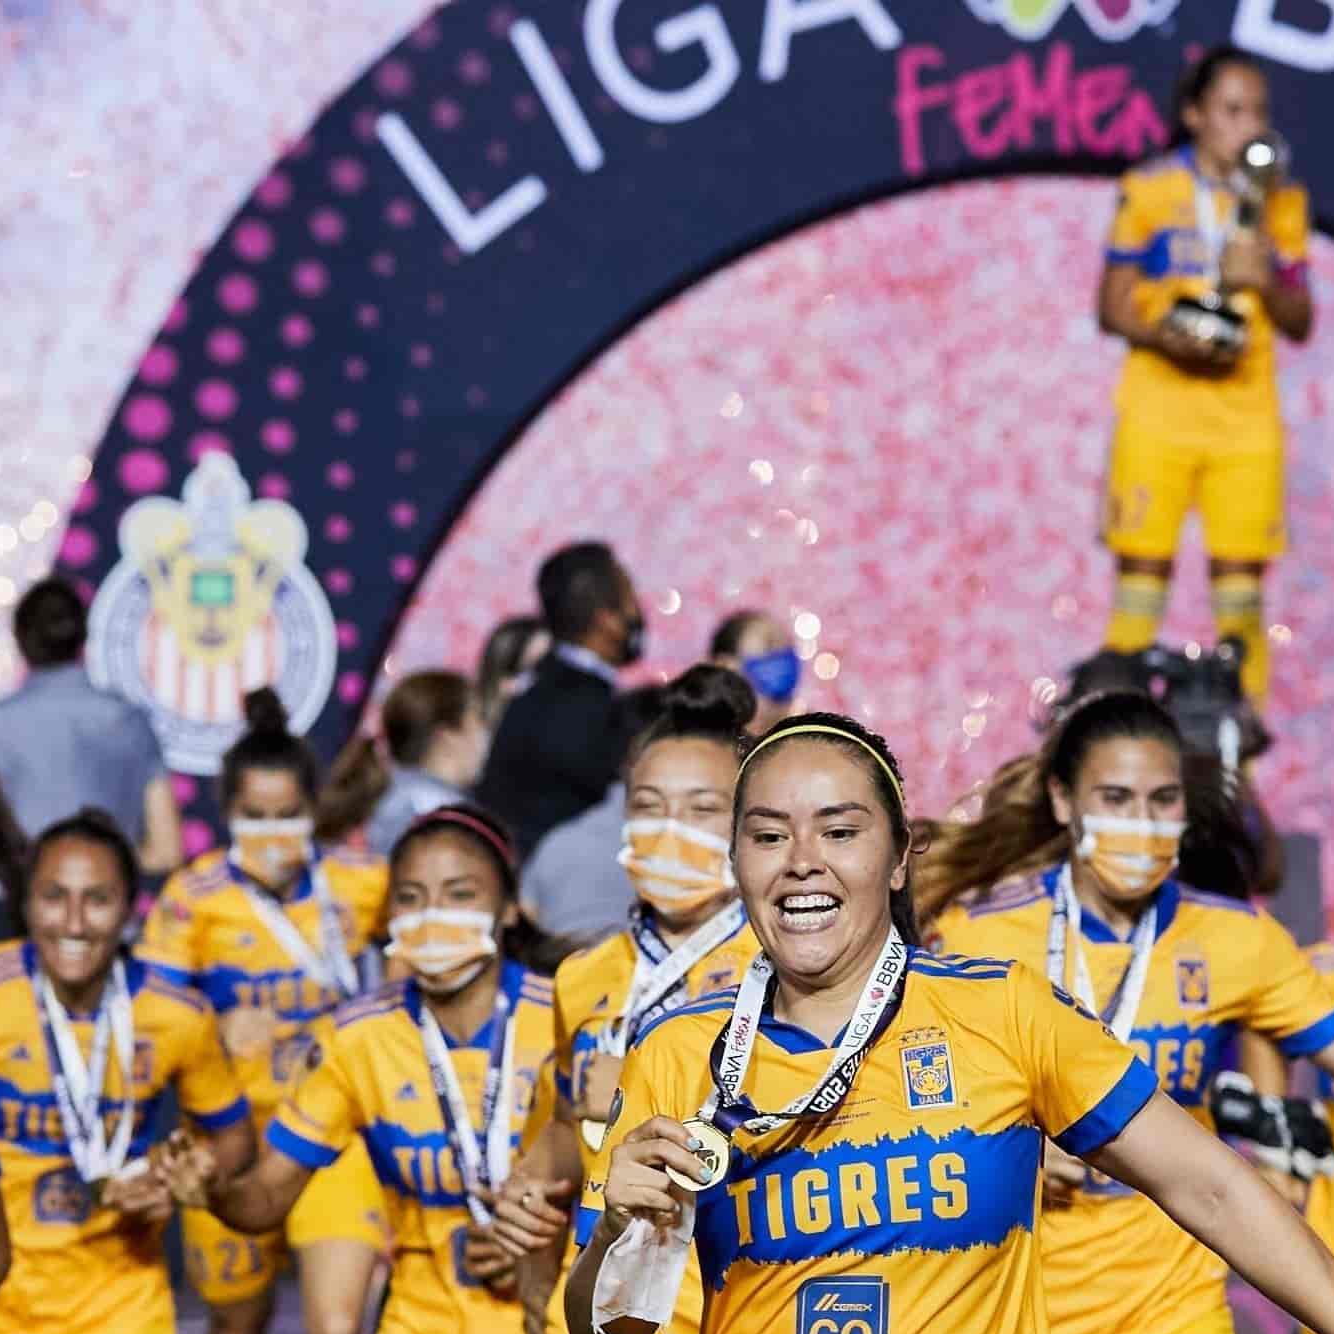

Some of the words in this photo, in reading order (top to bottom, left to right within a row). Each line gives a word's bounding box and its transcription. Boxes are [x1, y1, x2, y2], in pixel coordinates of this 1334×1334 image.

[845, 1009, 877, 1048] LIGA
[876, 937, 904, 987] BBVA
[727, 1151, 970, 1247] TIGRES
